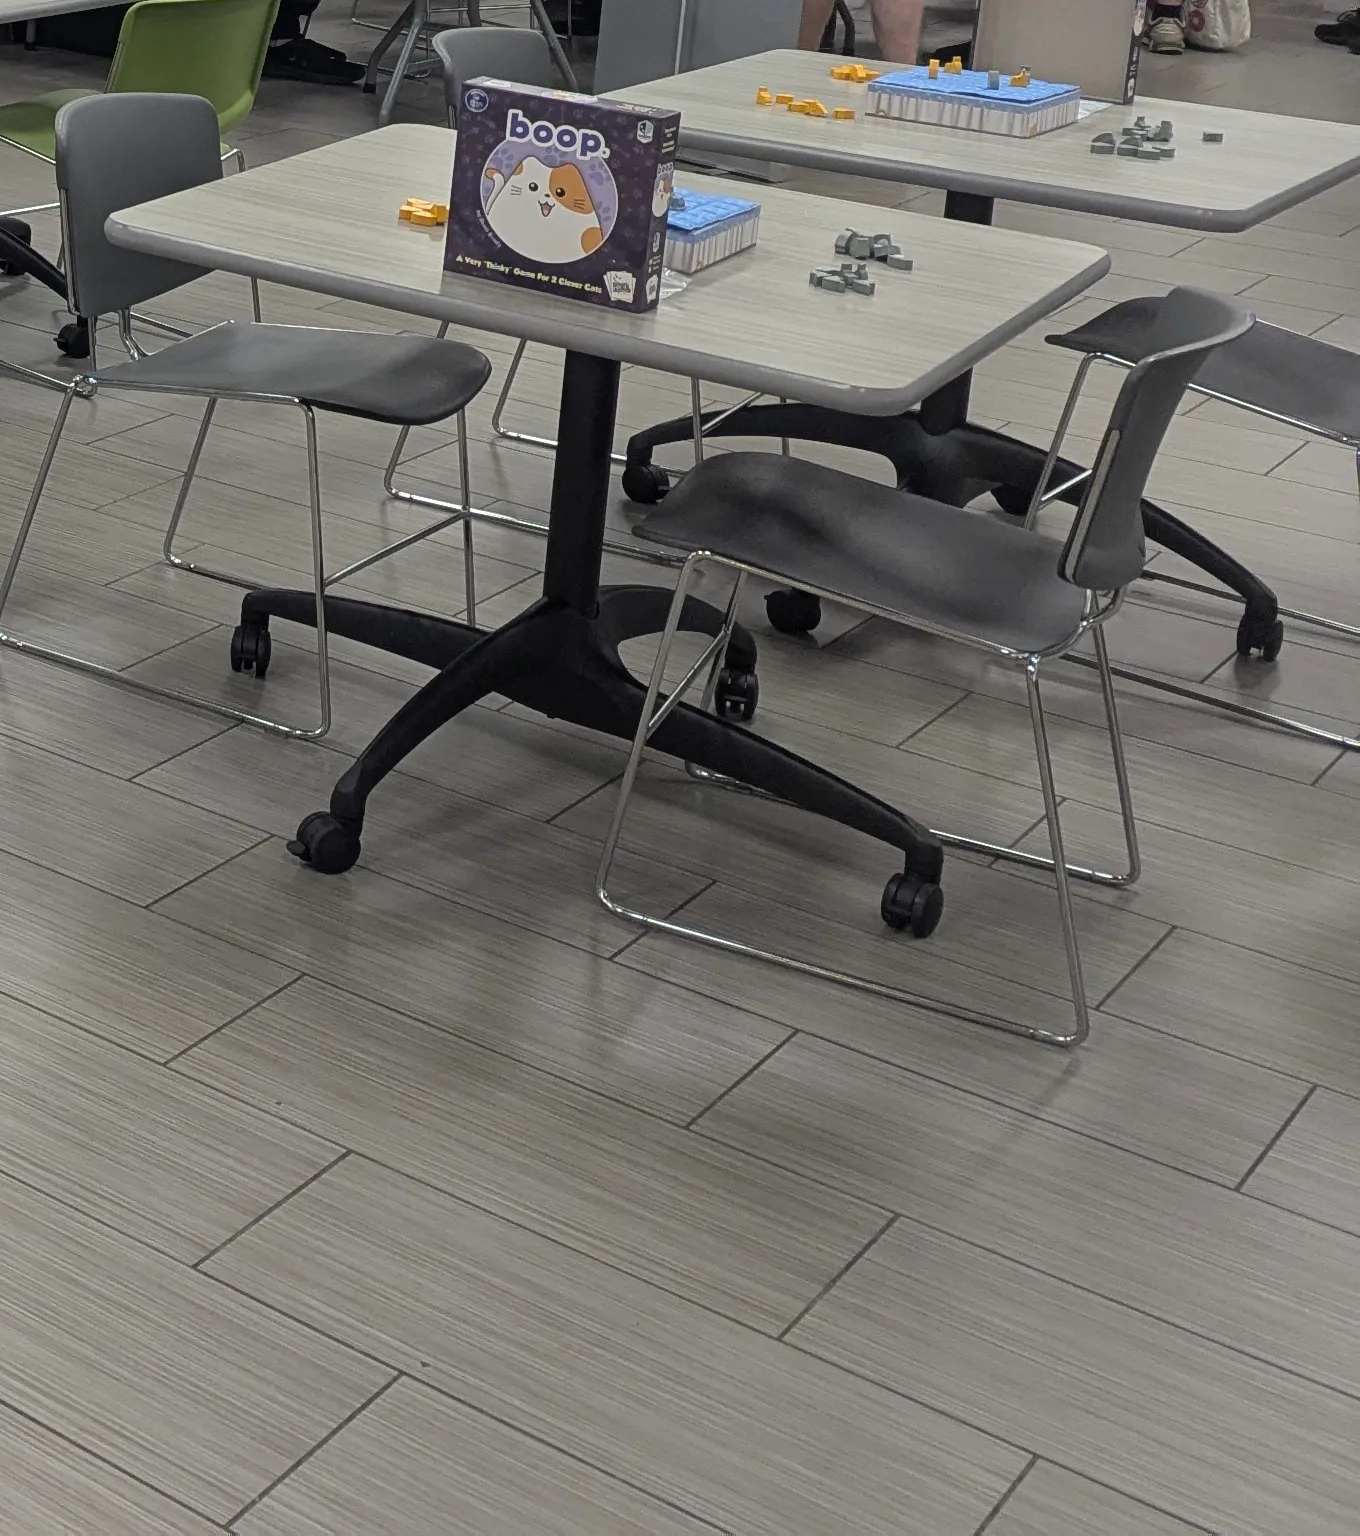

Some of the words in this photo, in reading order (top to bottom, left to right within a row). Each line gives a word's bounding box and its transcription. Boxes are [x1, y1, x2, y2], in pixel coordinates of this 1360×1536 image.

[506, 109, 610, 160] boop.
[456, 255, 463, 263] A
[464, 256, 482, 268] Very
[513, 267, 536, 279] Game
[537, 272, 550, 282] For
[551, 275, 557, 284] 2
[558, 277, 583, 289] Clever
[584, 283, 603, 294] Cats
